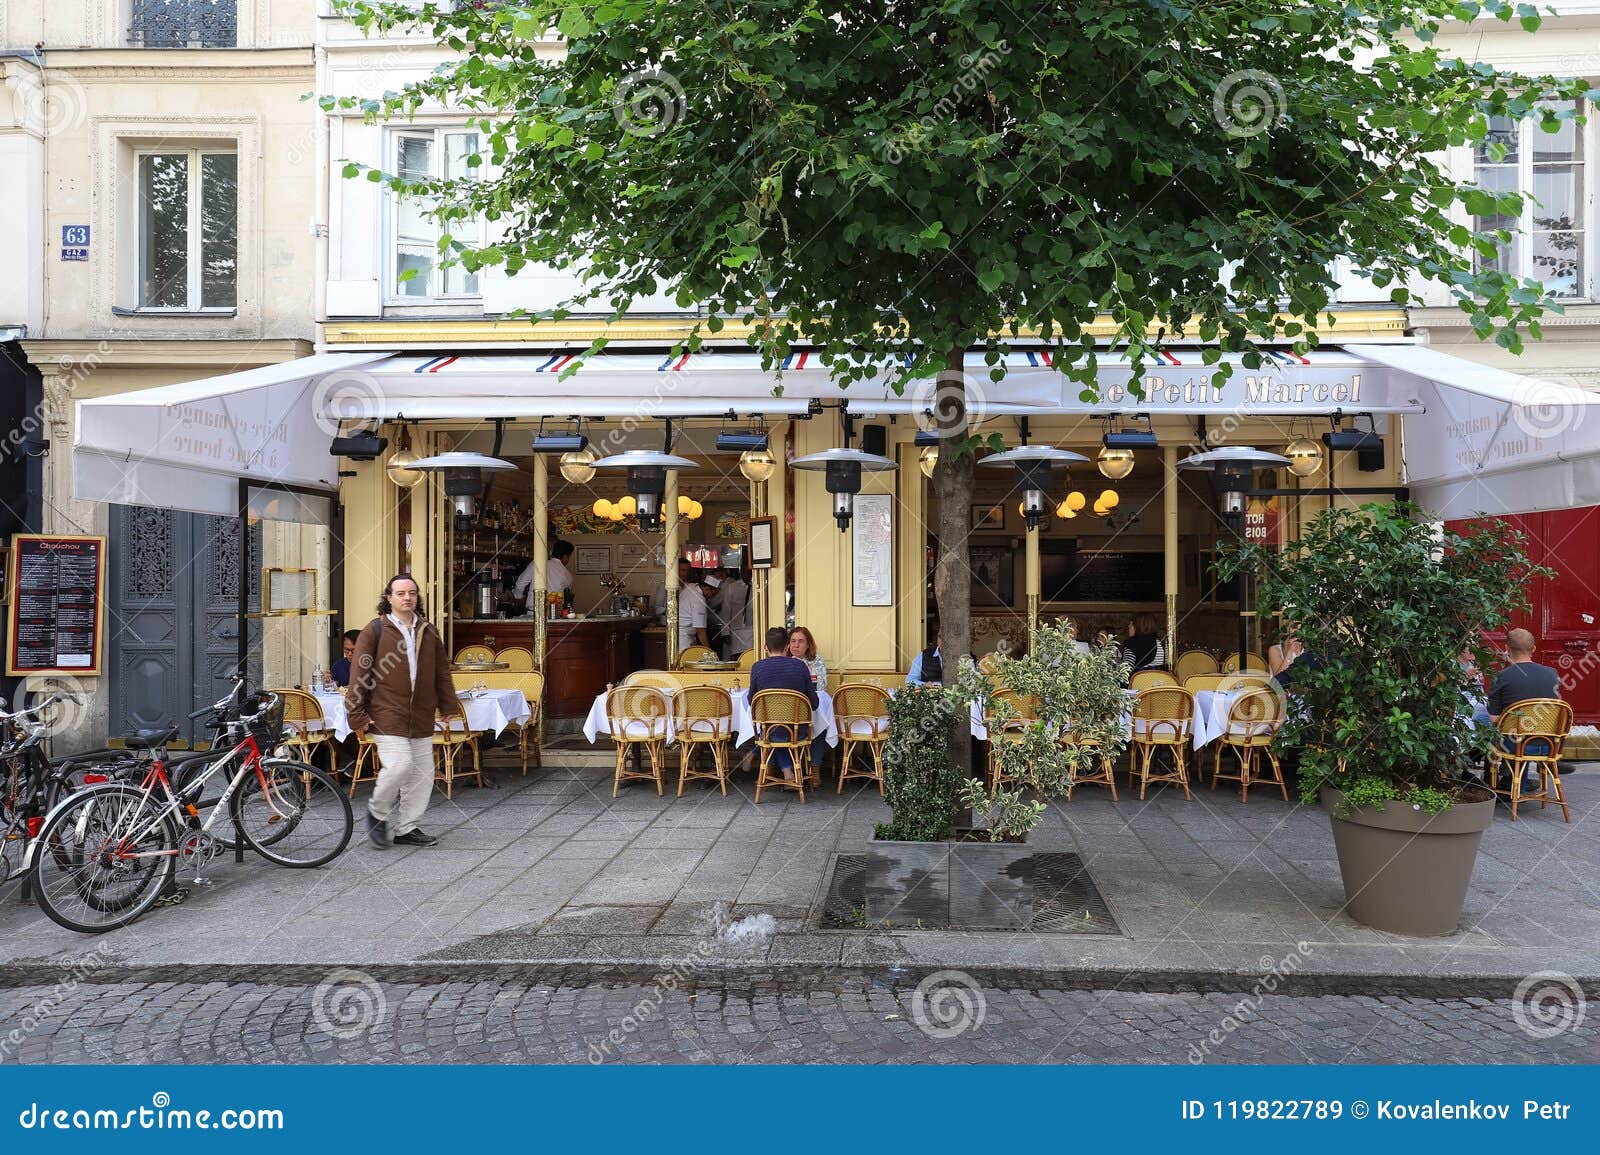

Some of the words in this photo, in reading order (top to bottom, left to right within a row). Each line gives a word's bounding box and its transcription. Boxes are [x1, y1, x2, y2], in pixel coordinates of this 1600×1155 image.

[66, 228, 86, 243] 63
[1143, 375, 1224, 404] Petit
[1244, 375, 1363, 404] Marcel
